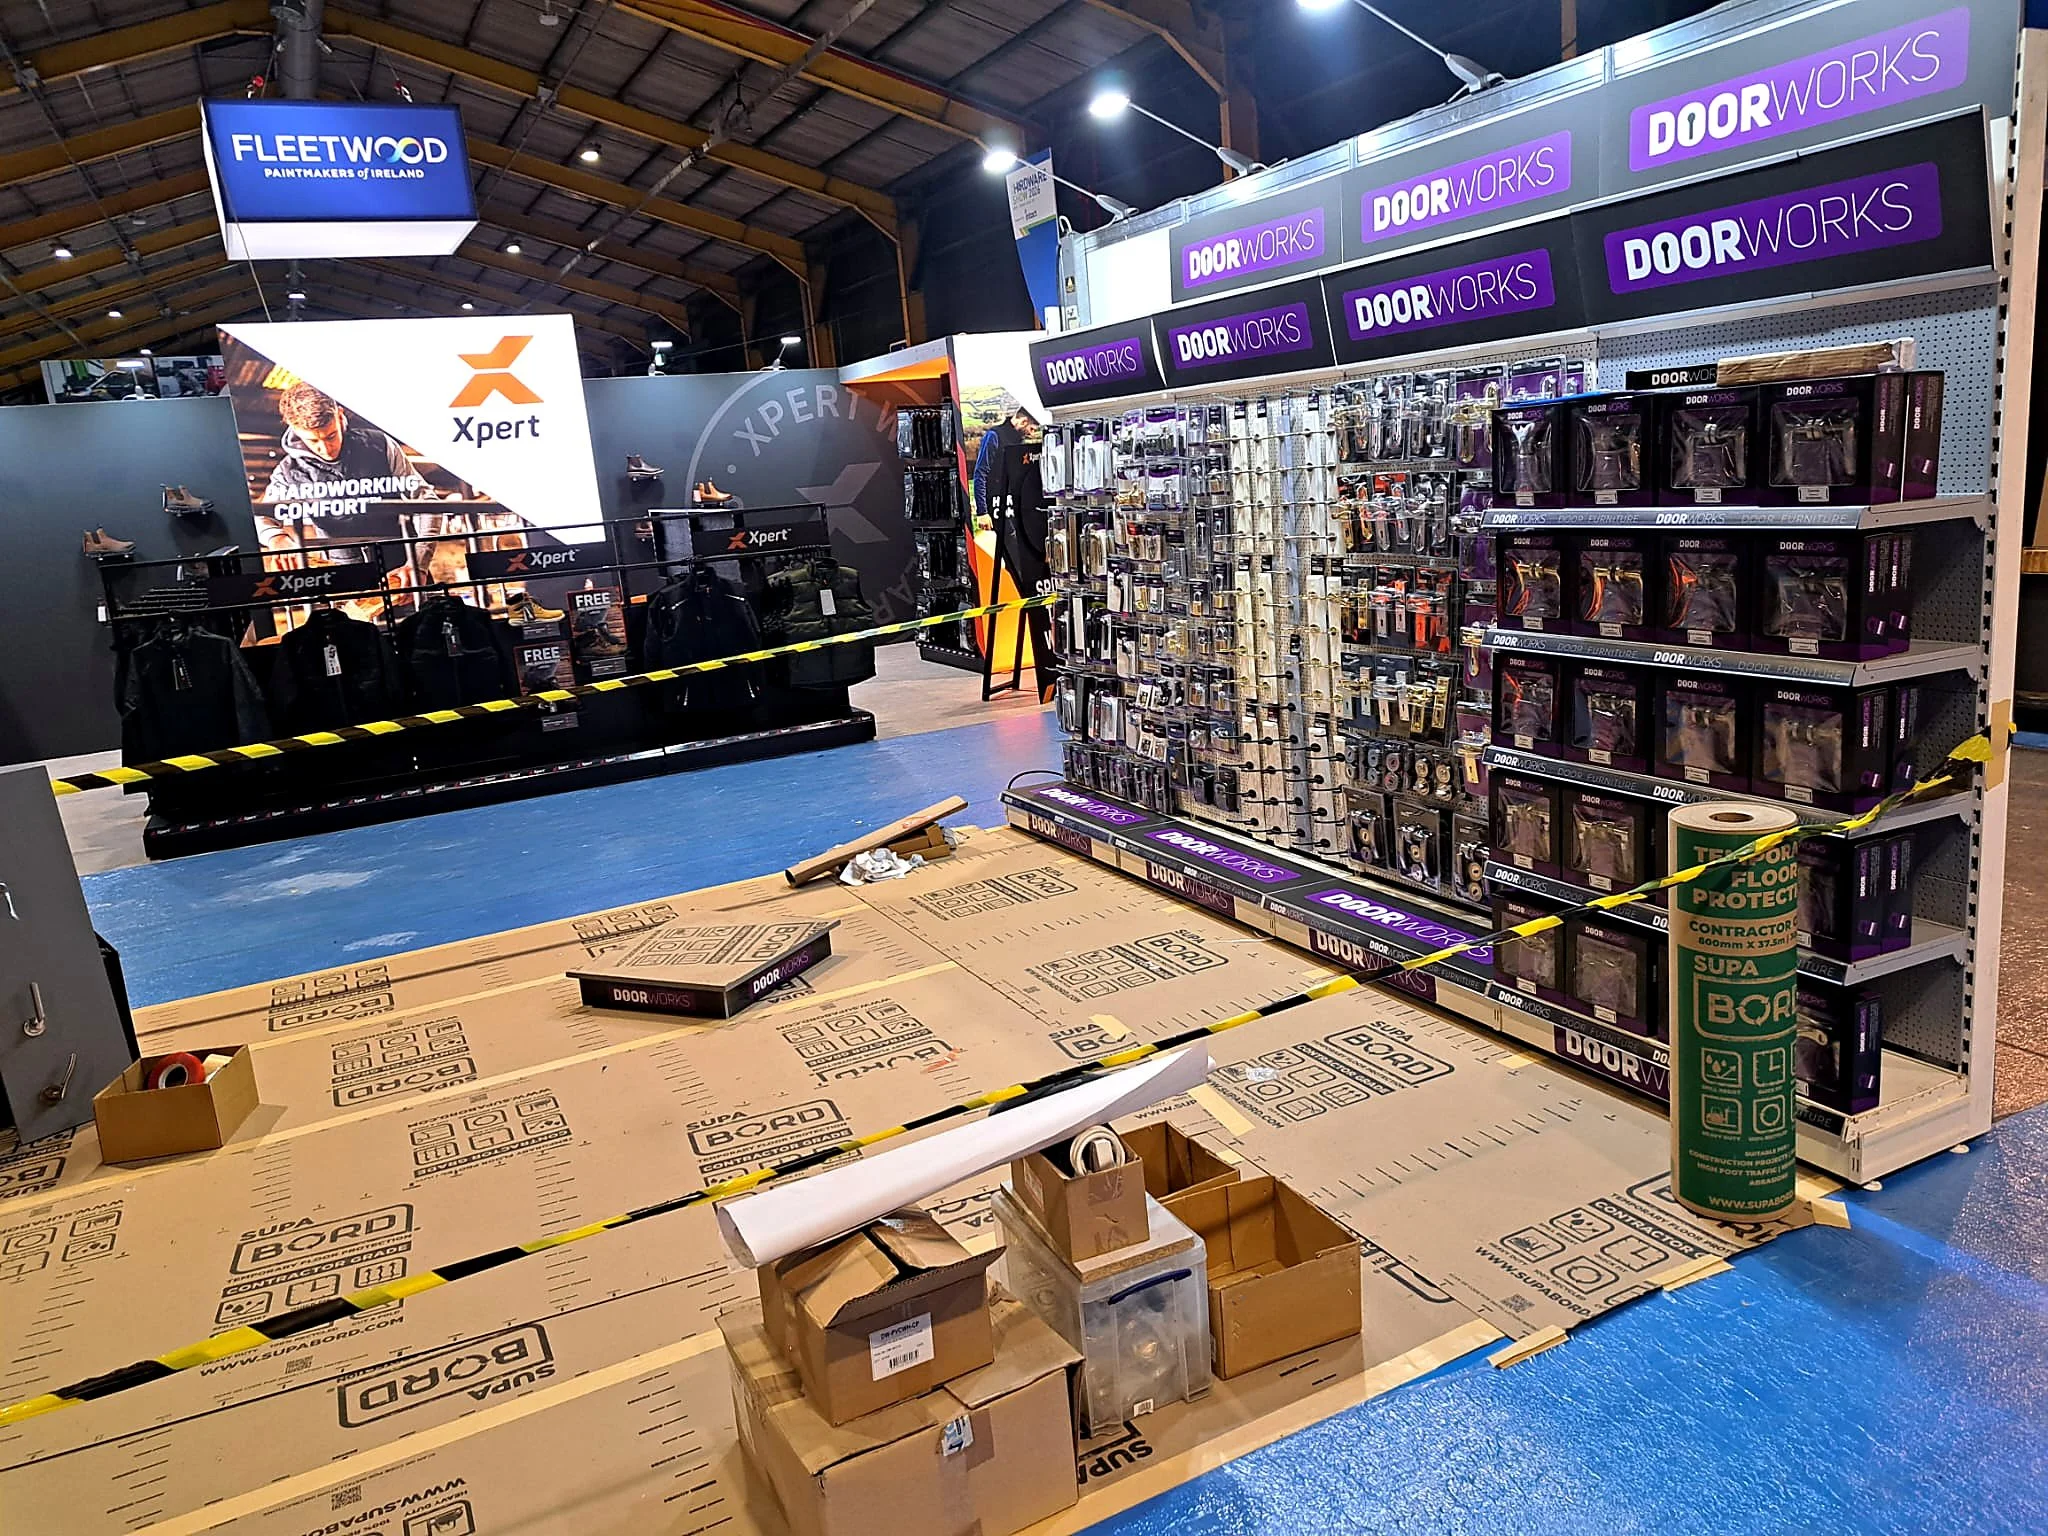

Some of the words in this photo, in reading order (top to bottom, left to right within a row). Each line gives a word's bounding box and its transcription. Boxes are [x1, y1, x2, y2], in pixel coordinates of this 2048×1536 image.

[1648, 30, 1941, 157] DOORWORKS
[231, 134, 448, 164] FLEETWOOD
[264, 167, 355, 179] PAINTMAKERS
[357, 167, 369, 180] of
[371, 168, 425, 179] IRELAND
[1372, 146, 1556, 233] DOORWORKS
[1623, 182, 1914, 282] DOORWORKS
[1188, 218, 1315, 281] DOORWORKS
[1355, 262, 1538, 331] DOORWORKS
[1177, 312, 1302, 363] DOORWORKS
[1045, 349, 1137, 387] DOORWORKS
[1652, 369, 1716, 386] DOORWOR
[1786, 383, 1844, 396] DOORWORKS
[452, 414, 541, 448] Xpert
[733, 384, 867, 457] XPERT
[266, 475, 419, 502] HARDWORKING
[1492, 513, 1546, 524] DOORWORKS
[1656, 513, 1726, 525] DOORWORKS
[575, 592, 612, 608] FREE
[523, 646, 560, 663] FREE
[1493, 635, 1546, 649] DOORWORKS
[1654, 651, 1722, 668] DOORWORKS
[1494, 753, 1546, 773] DOORWORKS
[1040, 788, 1135, 822] DOORWORKS
[1031, 815, 1089, 851] DOORWORKS
[1156, 831, 1284, 880] DOORWORKS
[1018, 873, 1064, 894] BORD
[1151, 863, 1229, 910] DOORWORKS
[1495, 868, 1548, 893] DOORWORKS
[1731, 863, 1798, 888] FLOOR
[1692, 883, 1799, 909] PROTECTI
[1175, 929, 1205, 944] SUPA
[1689, 920, 1791, 937] CONTRACTOR
[1149, 937, 1213, 966] BORD
[1694, 955, 1759, 977] SUPA
[753, 950, 809, 994] DOORWORKS
[613, 988, 690, 1008] DOORWORKS
[768, 989, 817, 1004] SUPA
[1498, 990, 1551, 1019] DOORWORKS
[280, 998, 382, 1027] BORD
[343, 1006, 395, 1021] SUPA
[1048, 1023, 1099, 1040] SUPA
[1370, 1020, 1416, 1042] SUPA
[1297, 1044, 1356, 1080] CONTRACTOR
[1354, 1074, 1391, 1094] GRADE
[1342, 1033, 1435, 1076] BORD
[347, 1063, 462, 1099] BORD
[420, 1076, 478, 1093] SUPA
[686, 1111, 748, 1130] SUPA
[706, 1107, 825, 1147] BORD
[472, 1129, 570, 1160] CONTRACTOR
[702, 1142, 800, 1172] CONTRACTOR
[800, 1129, 851, 1149] GRADE
[415, 1156, 470, 1177] GRADE
[240, 1217, 315, 1241] SUPA
[251, 1214, 396, 1263] BORD
[1595, 1200, 1694, 1253] CONTRACTOR
[226, 1262, 298, 1283] TEMPORARY
[342, 1233, 413, 1255] PROTECTION
[1703, 1237, 1732, 1254] PROT
[226, 1258, 347, 1295] CONTRACTOR
[350, 1244, 411, 1264] GRADE
[1475, 1246, 1593, 1317] WWW.SUPABORD.
[200, 1315, 404, 1377] WWW.SUPABORD.COM
[360, 1338, 529, 1409] BORD
[468, 1364, 556, 1400] SUPA
[404, 1503, 432, 1518] DUTY
[435, 1490, 468, 1505] HEAVY
